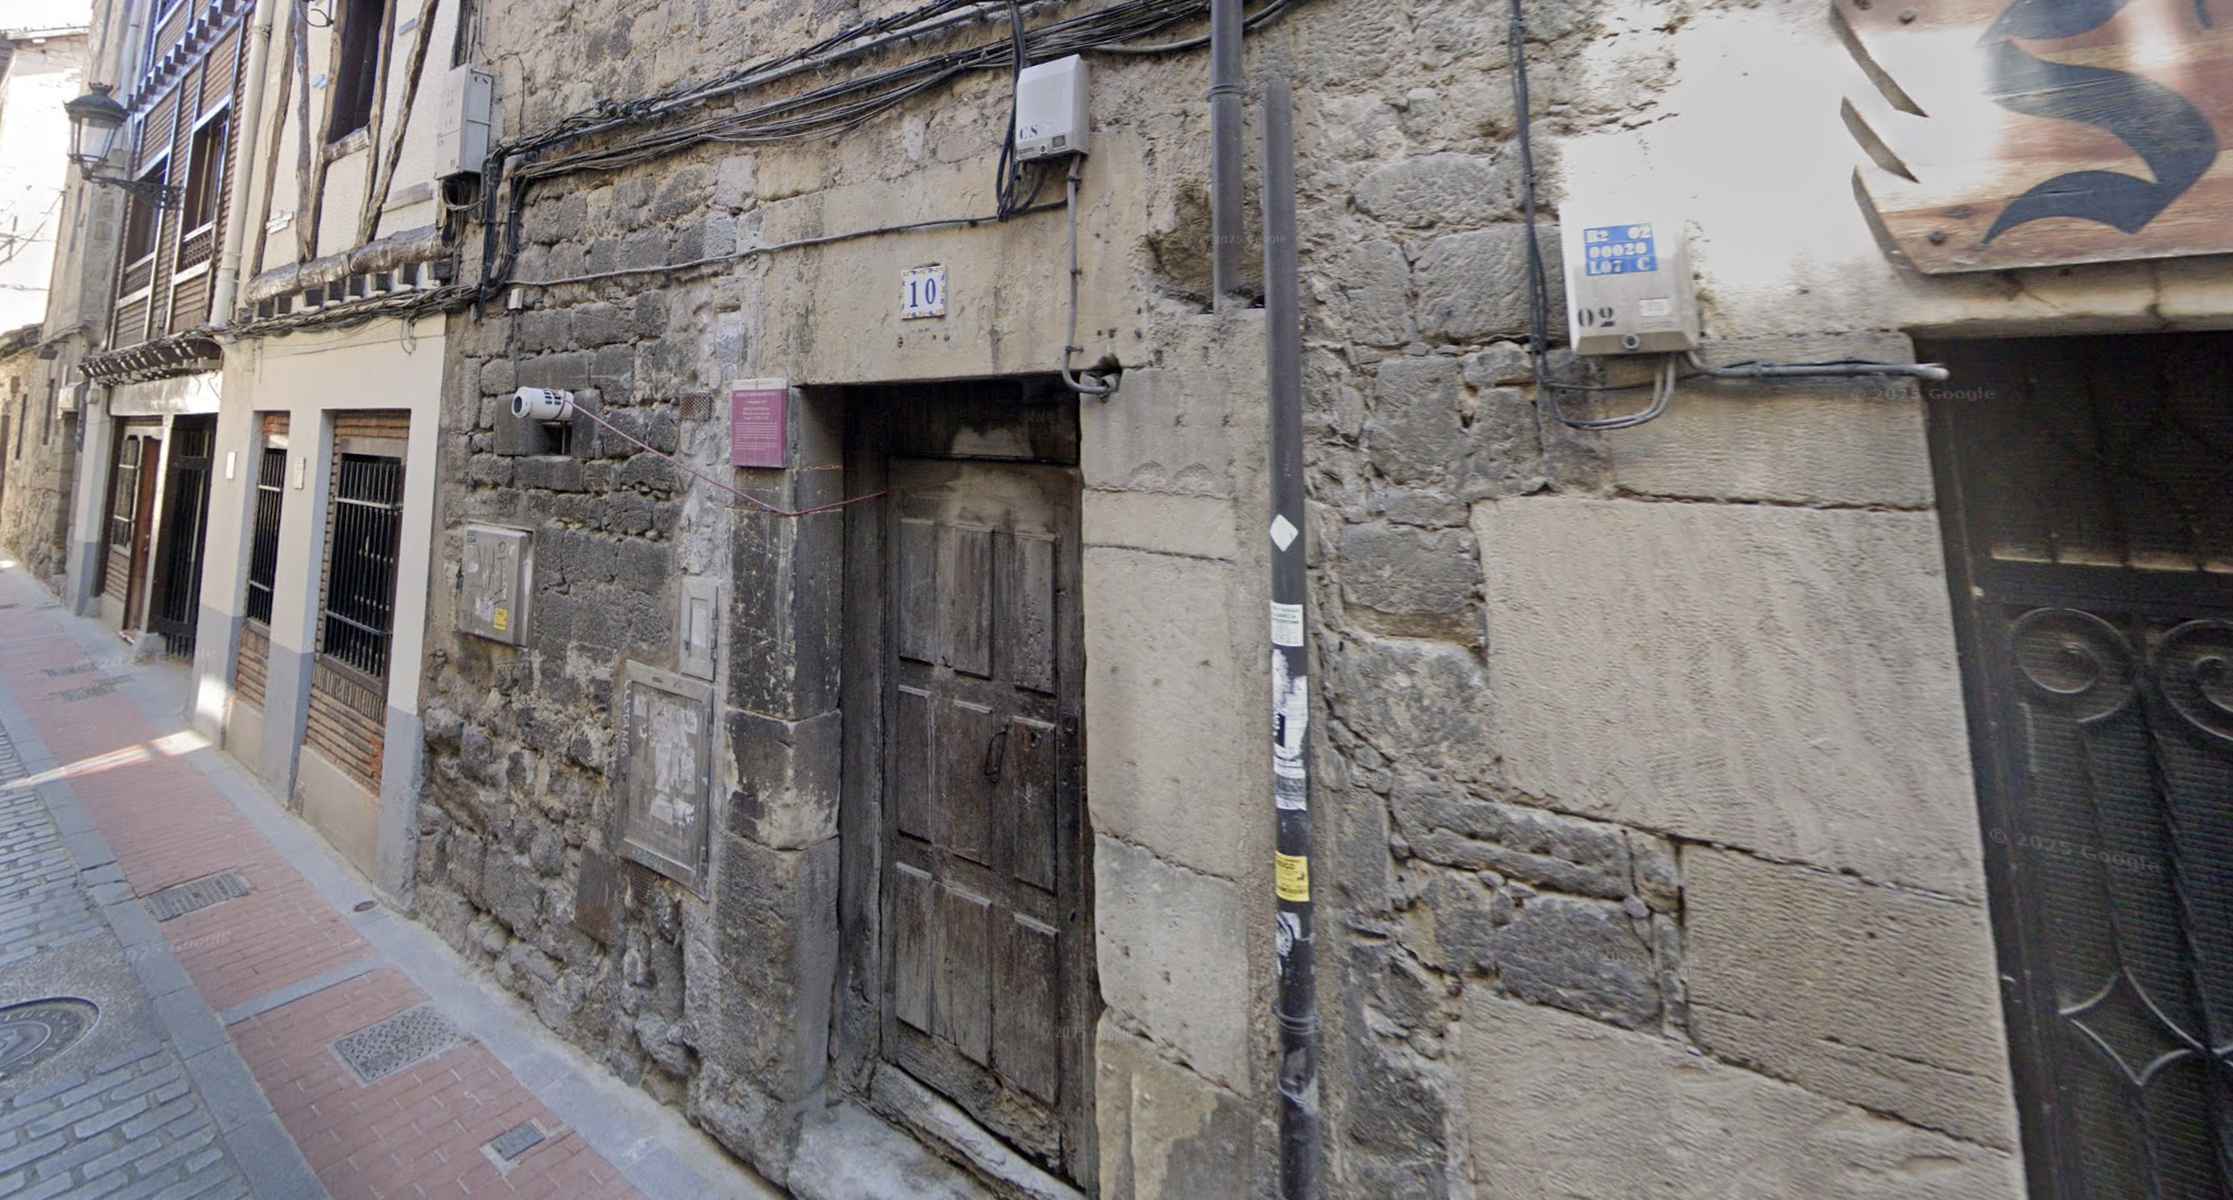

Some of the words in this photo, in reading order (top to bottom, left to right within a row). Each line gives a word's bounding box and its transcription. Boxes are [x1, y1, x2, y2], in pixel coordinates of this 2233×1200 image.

[1588, 242, 1648, 258] 00020
[910, 278, 936, 308] 10
[1577, 306, 1616, 328] 02
